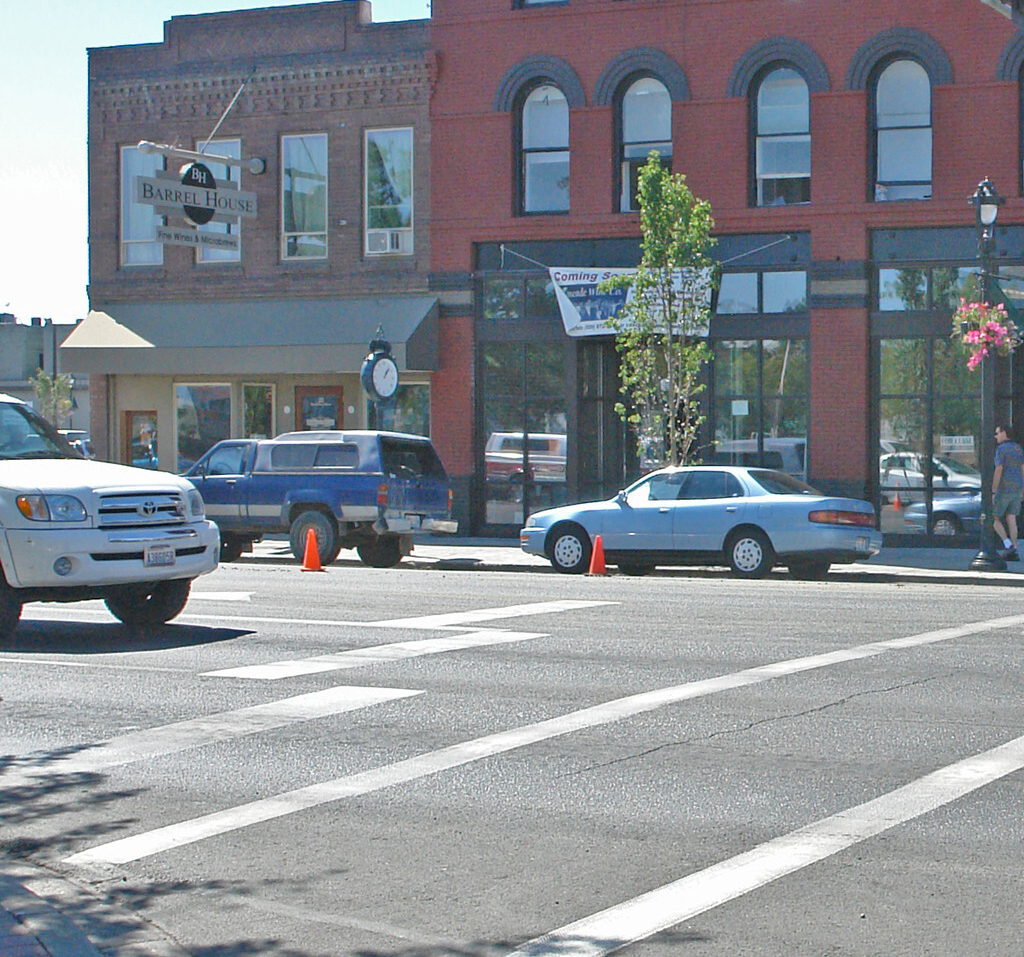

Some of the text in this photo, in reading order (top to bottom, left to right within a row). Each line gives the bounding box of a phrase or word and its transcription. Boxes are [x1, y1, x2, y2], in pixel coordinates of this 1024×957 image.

[191, 168, 207, 184] BH
[142, 183, 253, 213] BARREL HOUSE
[554, 271, 599, 283] Coming
